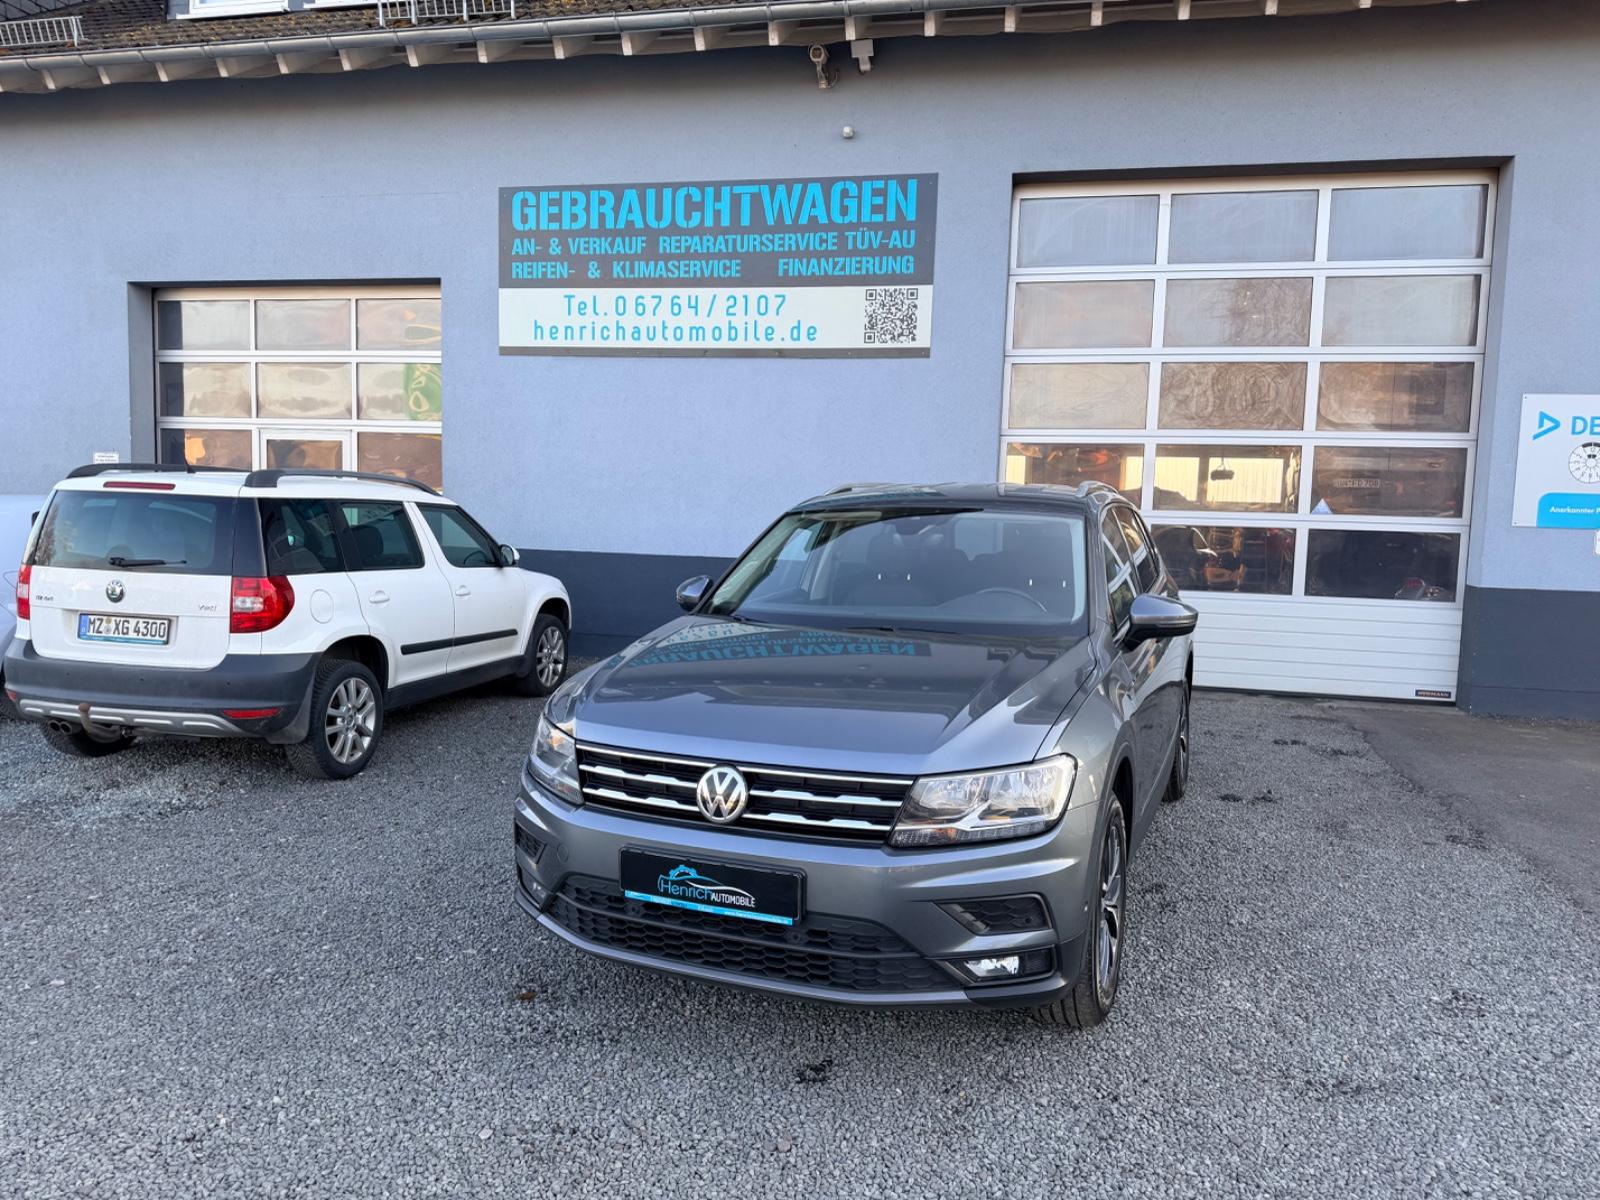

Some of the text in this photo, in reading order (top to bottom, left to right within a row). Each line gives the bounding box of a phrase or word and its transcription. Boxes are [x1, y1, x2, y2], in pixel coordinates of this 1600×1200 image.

[511, 179, 918, 231] GEBRAUCHTWAGEN
[511, 227, 916, 256] AN- & VERKAUF REPARATURSERVICE TÜV-AU
[511, 255, 915, 279] REIFEN- & KLIMASERVICE FINANZIERUNG
[534, 319, 818, 342] henrichautomobile.de
[88, 617, 167, 639] MZ XG 4300
[660, 880, 756, 908] Henrich AUTOMOBILE
